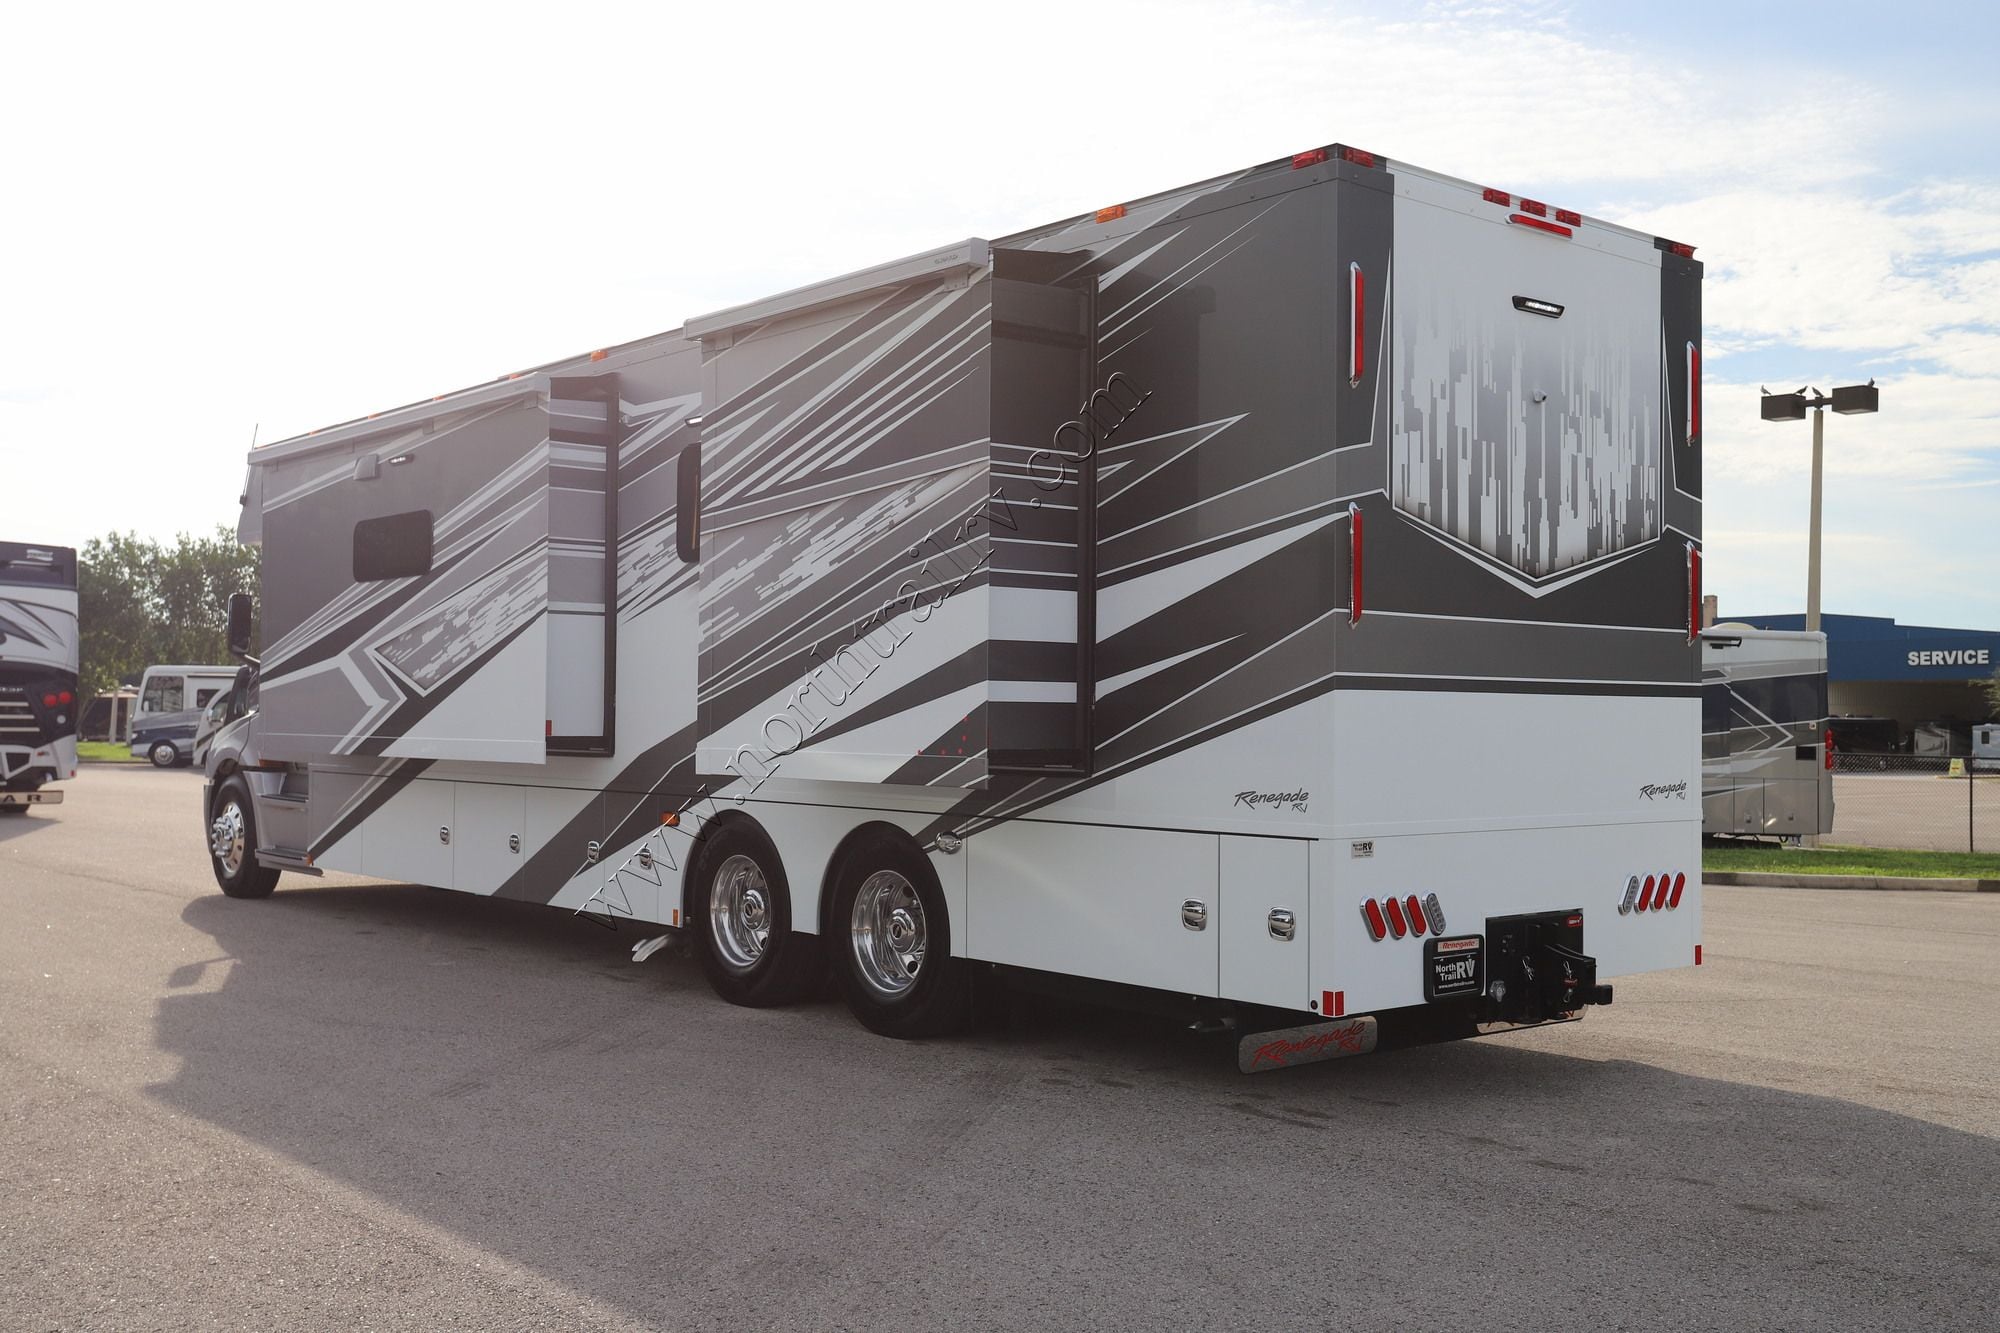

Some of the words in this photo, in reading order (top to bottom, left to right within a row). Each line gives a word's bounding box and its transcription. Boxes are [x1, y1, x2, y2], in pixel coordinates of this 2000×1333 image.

[1907, 649, 1990, 666] SERVICE
[1233, 787, 1309, 810] Renegade
[1639, 779, 1687, 801] Renegade
[1291, 802, 1308, 814] RV
[1362, 841, 1373, 851] RV
[1435, 963, 1457, 974] North
[1456, 958, 1476, 979] RV
[1440, 971, 1457, 982] Trail
[1251, 1020, 1366, 1068] Renegade
